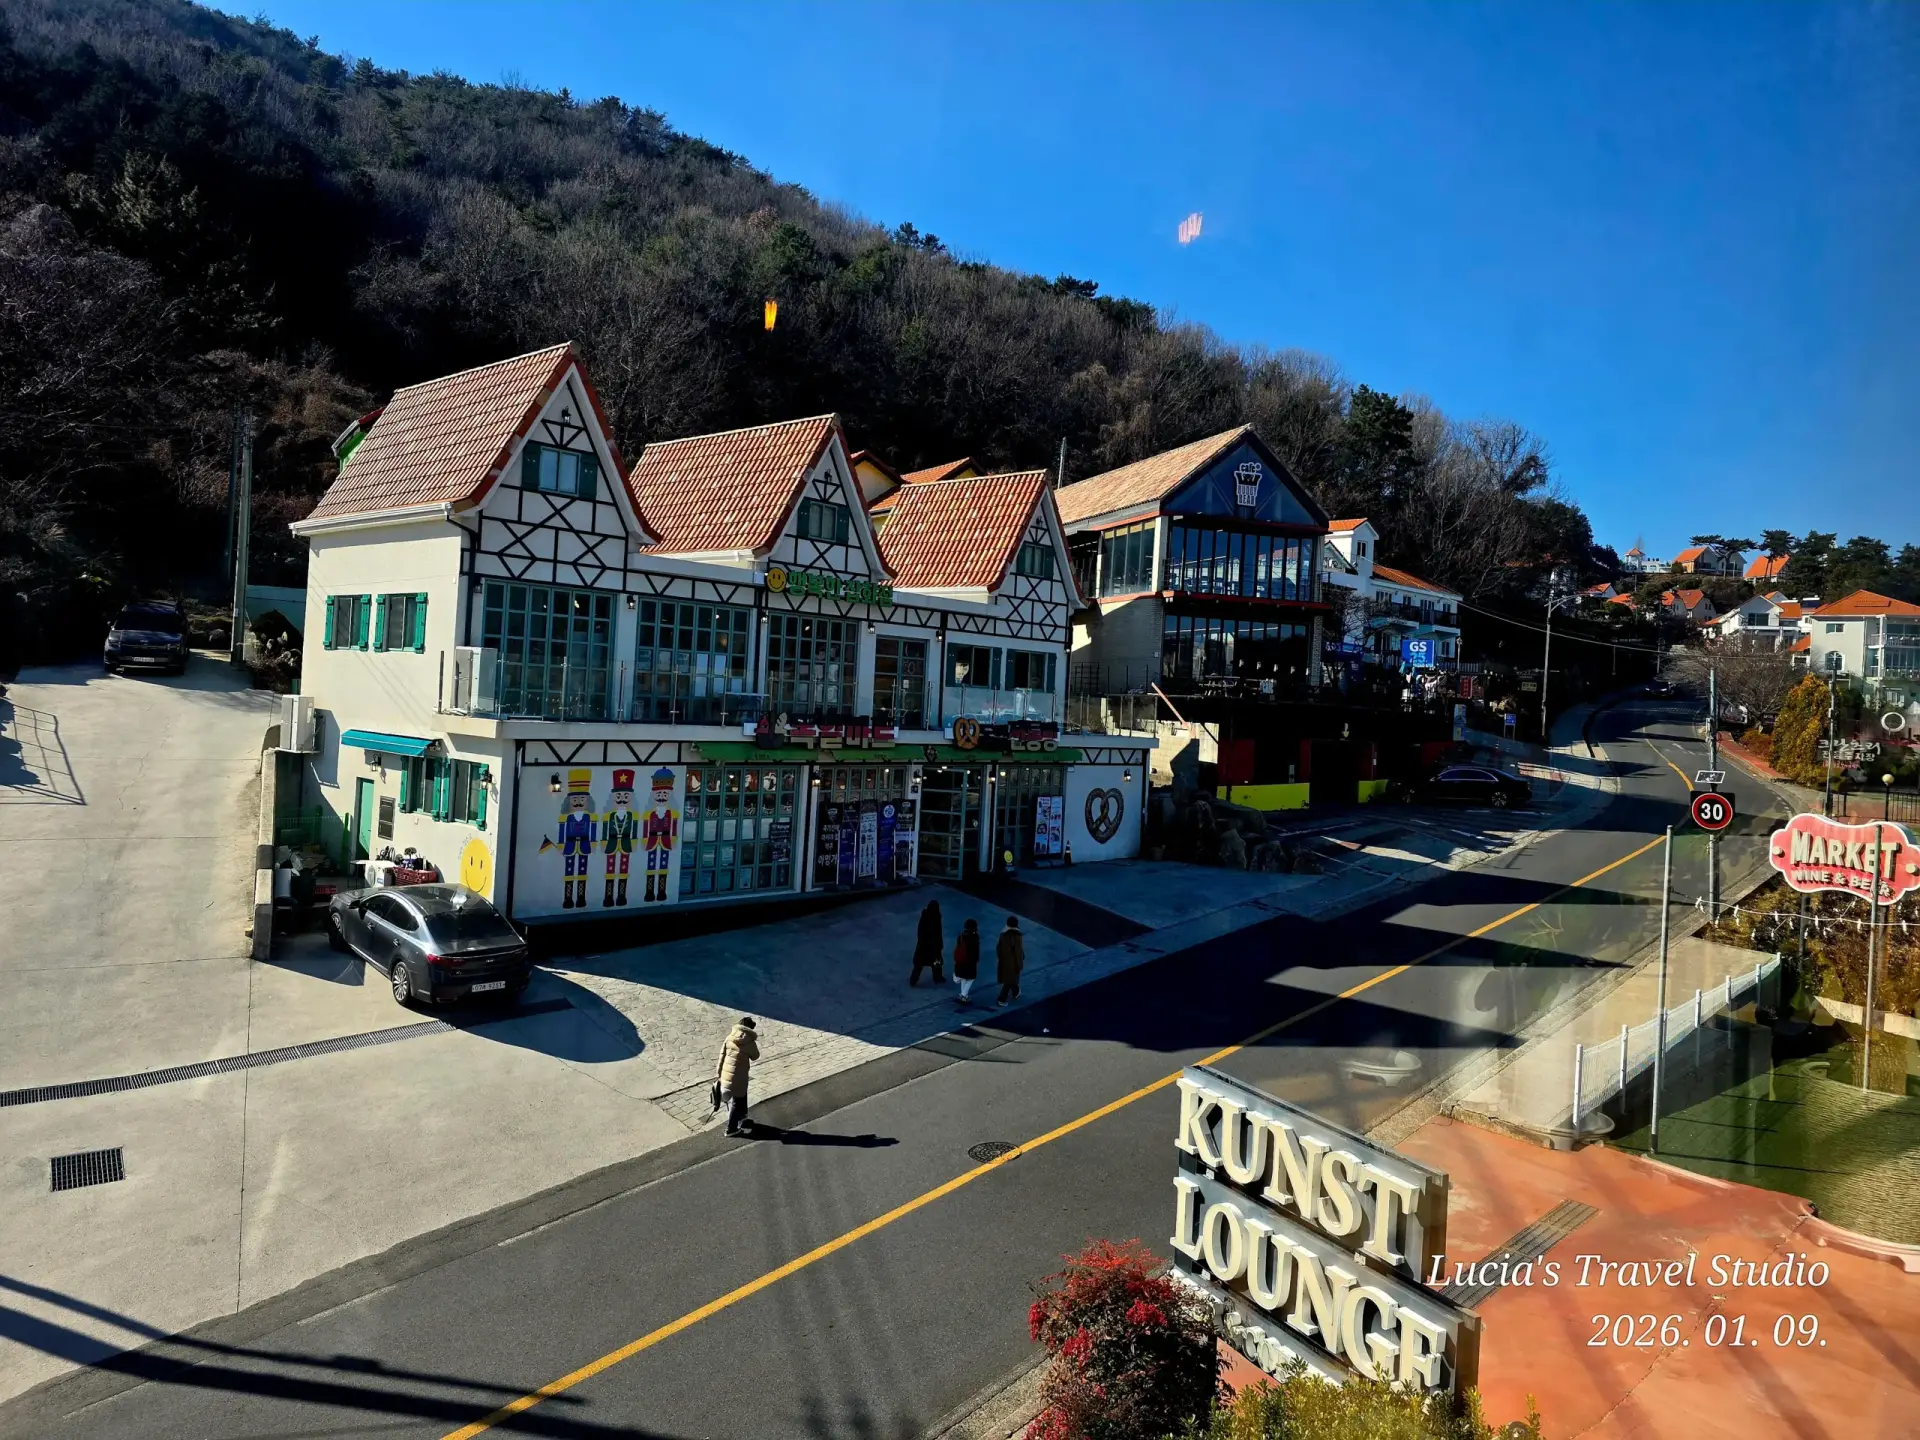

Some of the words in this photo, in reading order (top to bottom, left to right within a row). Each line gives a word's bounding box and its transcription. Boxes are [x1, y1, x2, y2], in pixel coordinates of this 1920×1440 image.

[1409, 641, 1427, 652] GS
[1701, 802, 1723, 821] 30
[1790, 828, 1900, 879] MARKET
[1791, 869, 1831, 883] WINE
[1833, 871, 1847, 885] &
[1849, 874, 1892, 898] BER
[1175, 1077, 1420, 1267] KUNST
[1170, 1176, 1448, 1393] LOUNGE
